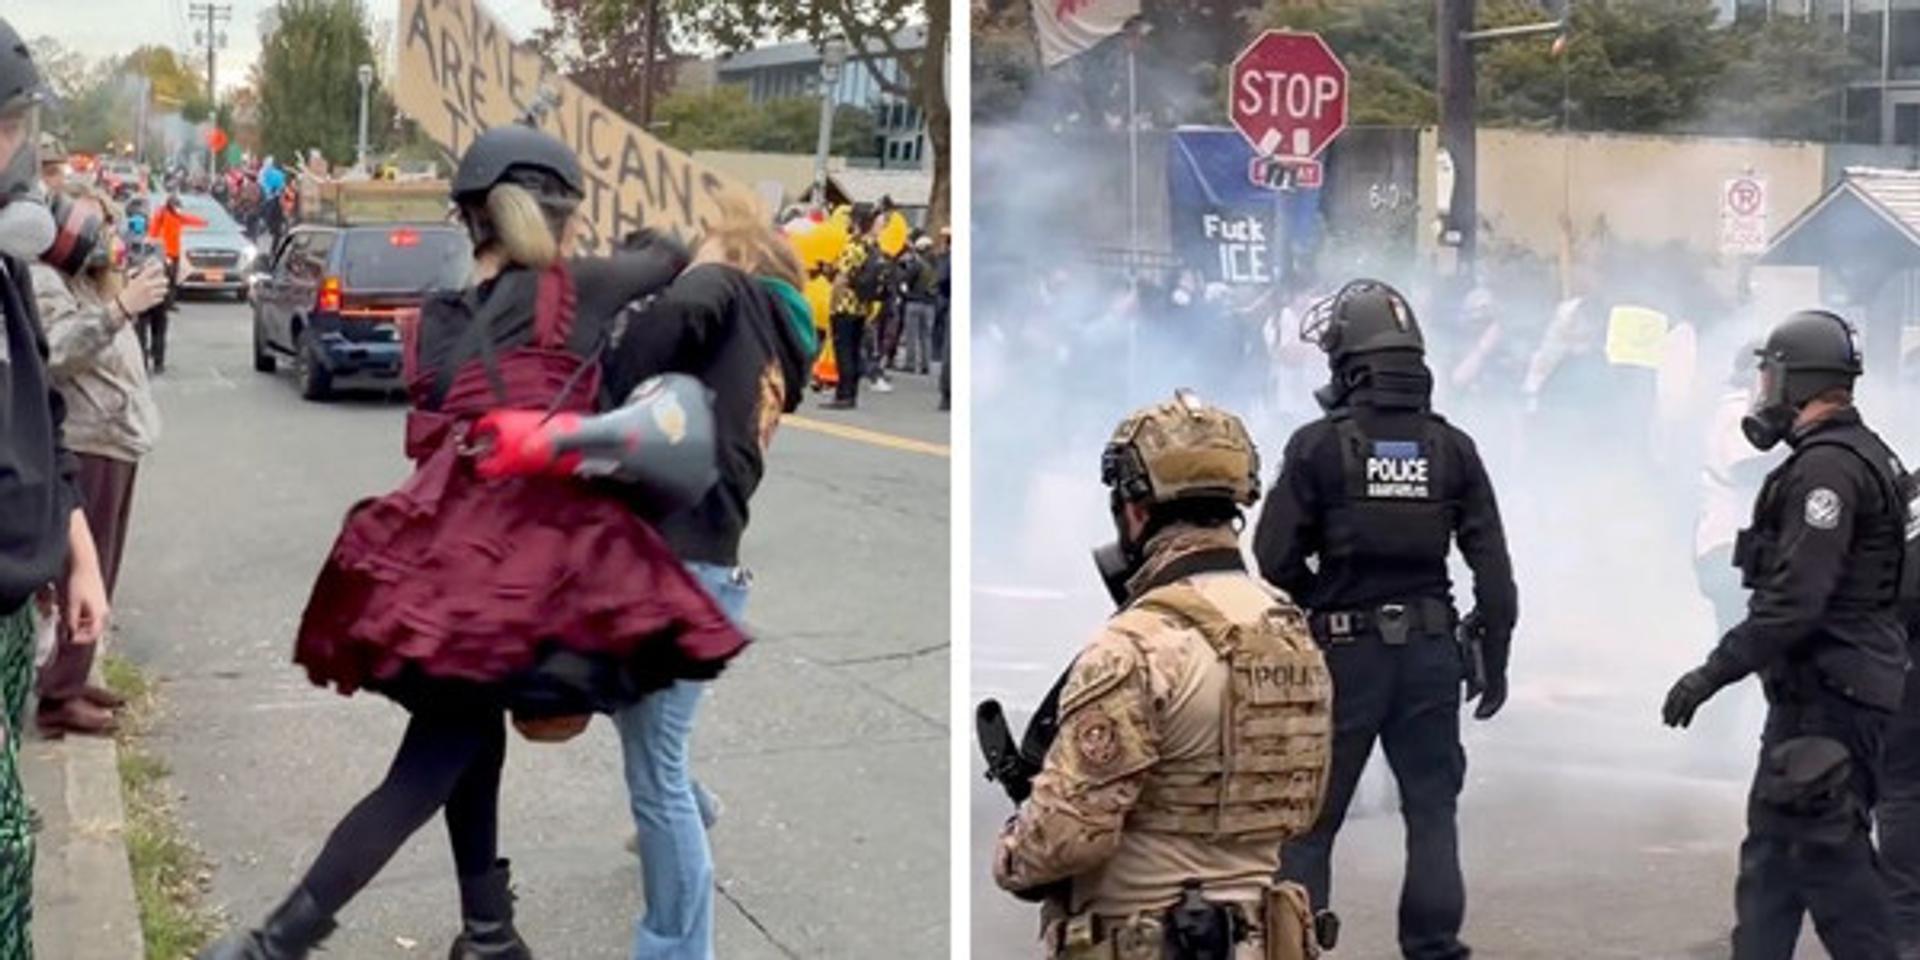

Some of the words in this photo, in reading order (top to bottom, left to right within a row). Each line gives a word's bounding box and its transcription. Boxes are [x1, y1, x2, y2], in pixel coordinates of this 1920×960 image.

[406, 0, 490, 131] ARE
[1239, 69, 1339, 120] STOP
[1202, 213, 1267, 243] Fuck
[1366, 457, 1430, 482] POLICE
